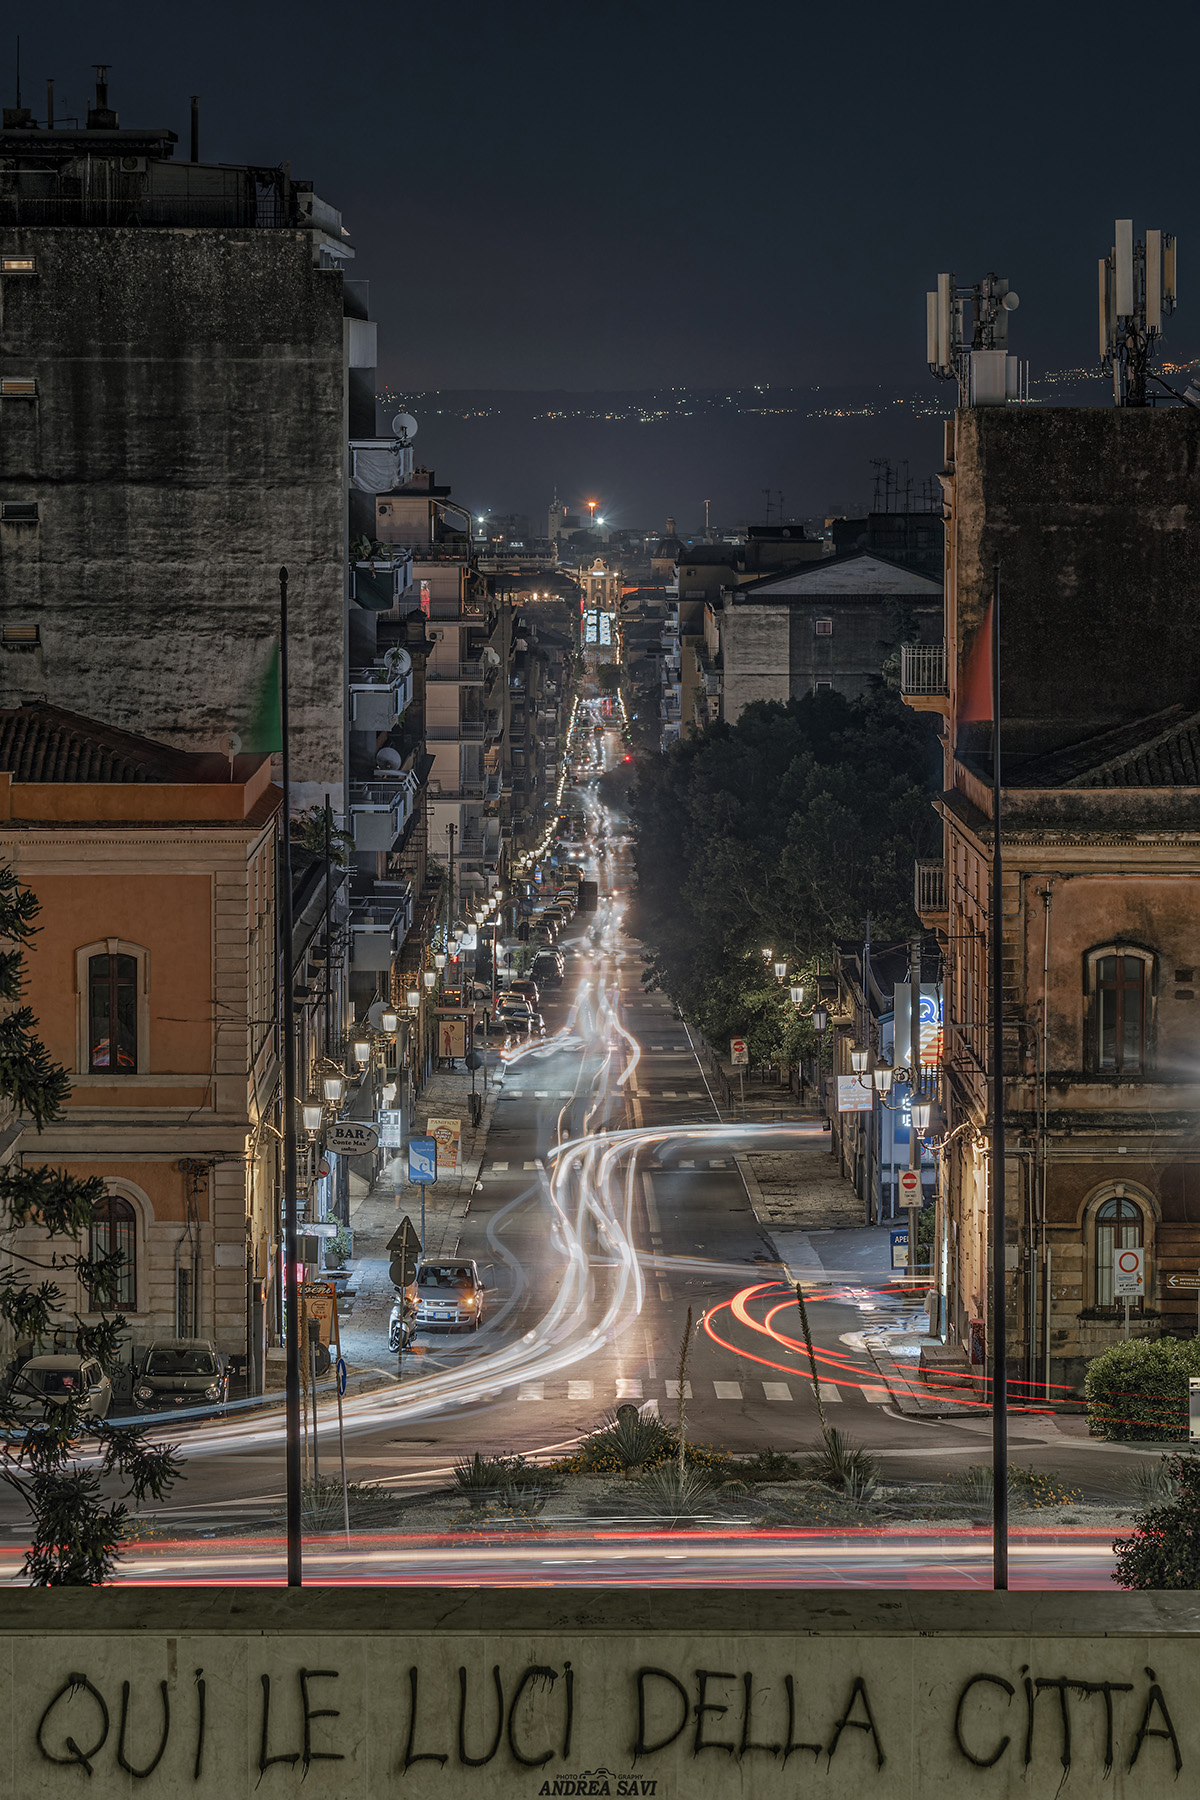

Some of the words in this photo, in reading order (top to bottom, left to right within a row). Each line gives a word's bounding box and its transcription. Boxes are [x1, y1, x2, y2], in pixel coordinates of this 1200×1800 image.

[335, 1128, 365, 1139] BAR
[257, 1667, 346, 1776] LE
[631, 1666, 885, 1770] DELLA
